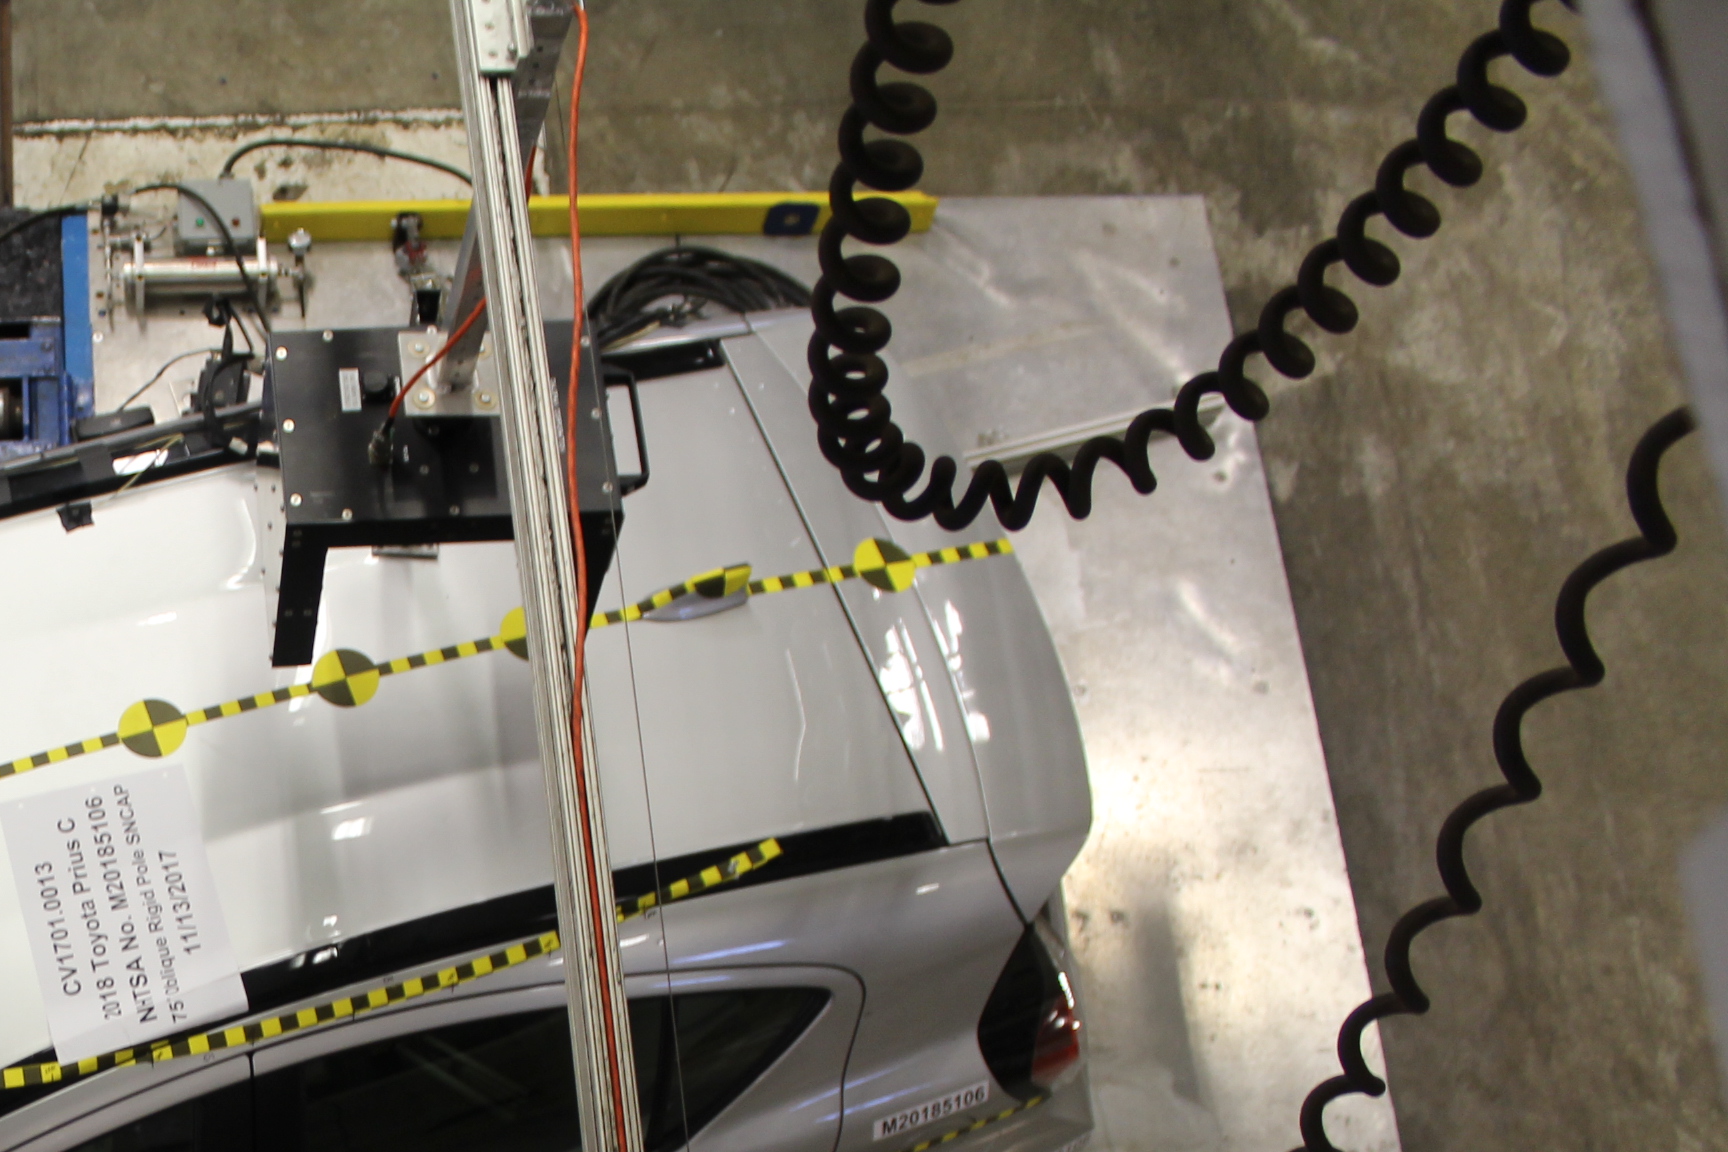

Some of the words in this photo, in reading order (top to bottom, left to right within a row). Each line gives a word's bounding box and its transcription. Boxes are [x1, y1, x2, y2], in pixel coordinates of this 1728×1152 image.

[57, 817, 75, 834] C
[114, 784, 140, 845] SNCAP
[67, 839, 90, 895] Prius
[85, 795, 129, 911] M20185106
[131, 849, 148, 887] Pole
[35, 862, 82, 996] CV1701.0013
[140, 890, 163, 933] Rigid
[158, 850, 200, 955] 11/13/2017
[80, 901, 109, 972] Toyota
[119, 916, 139, 952] No.
[156, 936, 180, 997] Oblique
[97, 977, 122, 1020] 2018
[882, 1088, 985, 1135] M20185106
